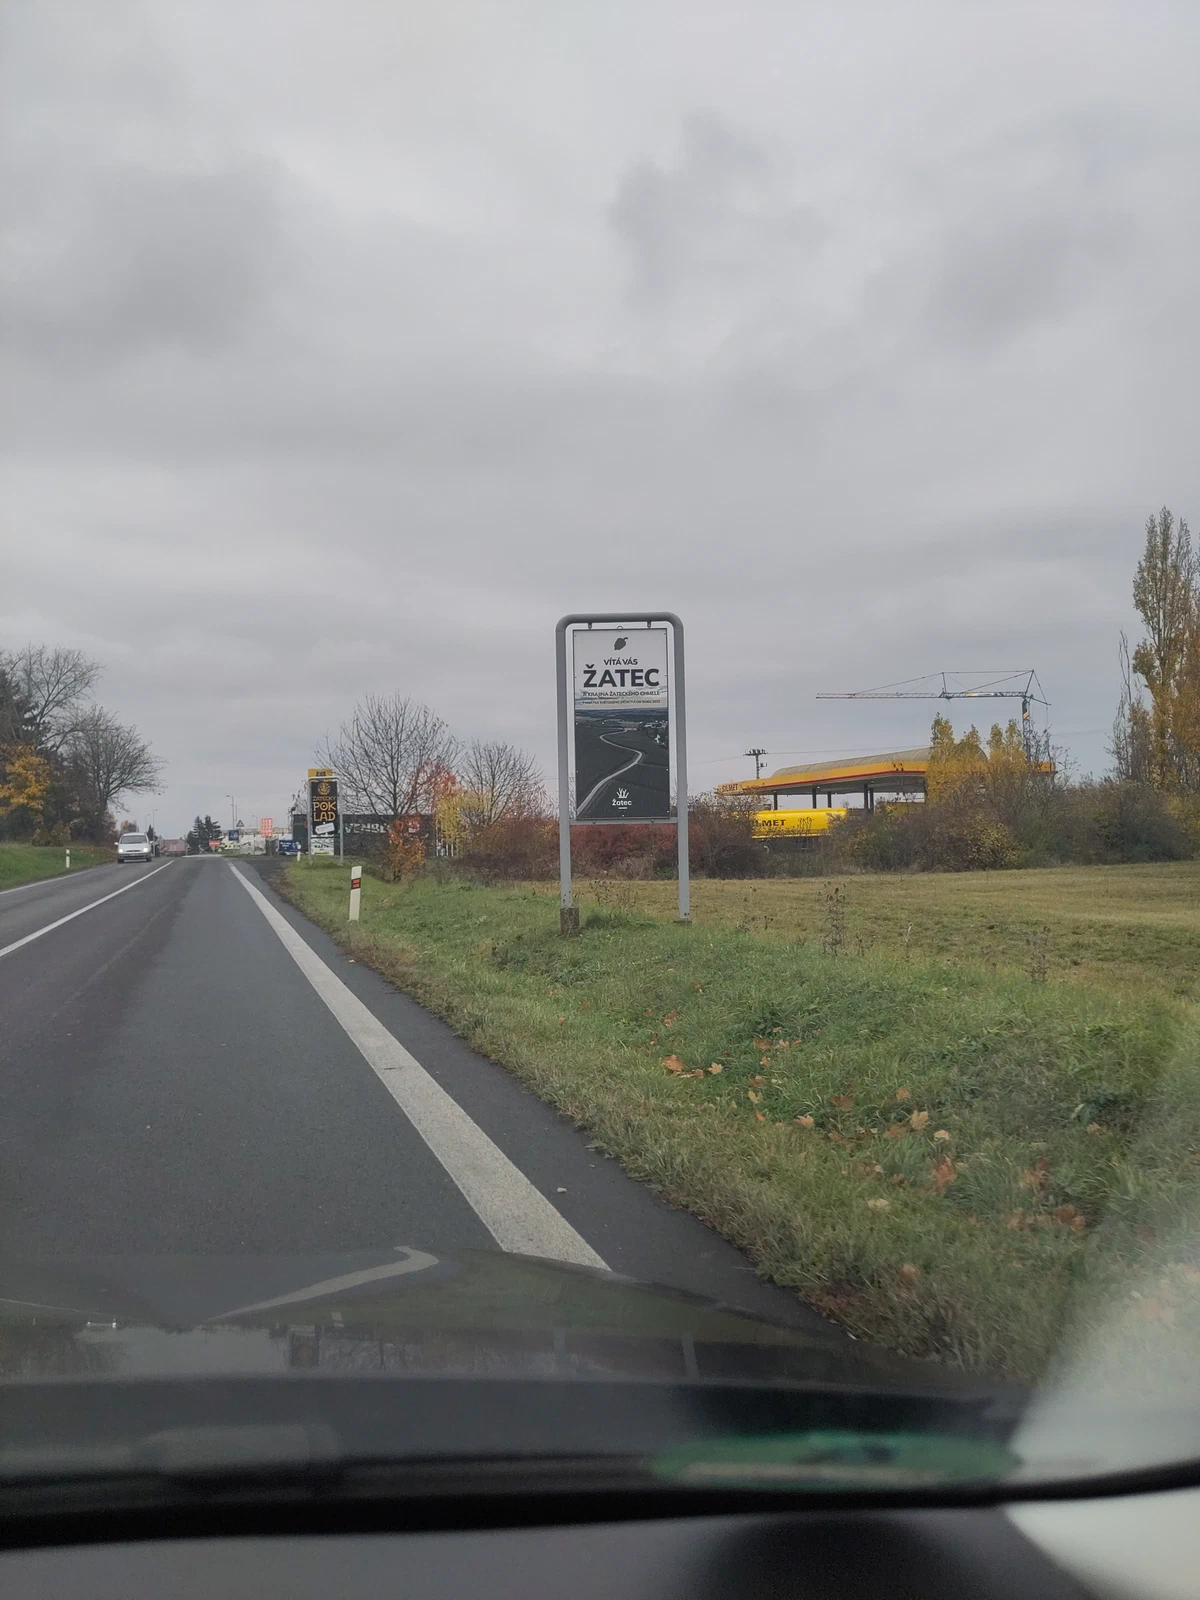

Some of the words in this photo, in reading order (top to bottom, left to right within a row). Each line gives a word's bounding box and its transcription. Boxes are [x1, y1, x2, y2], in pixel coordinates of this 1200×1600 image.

[603, 657, 622, 666] VÍTÁ
[622, 657, 638, 666] VÁS
[583, 664, 660, 687] ŽATEC
[313, 801, 336, 811] POK
[313, 811, 336, 822] LAD
